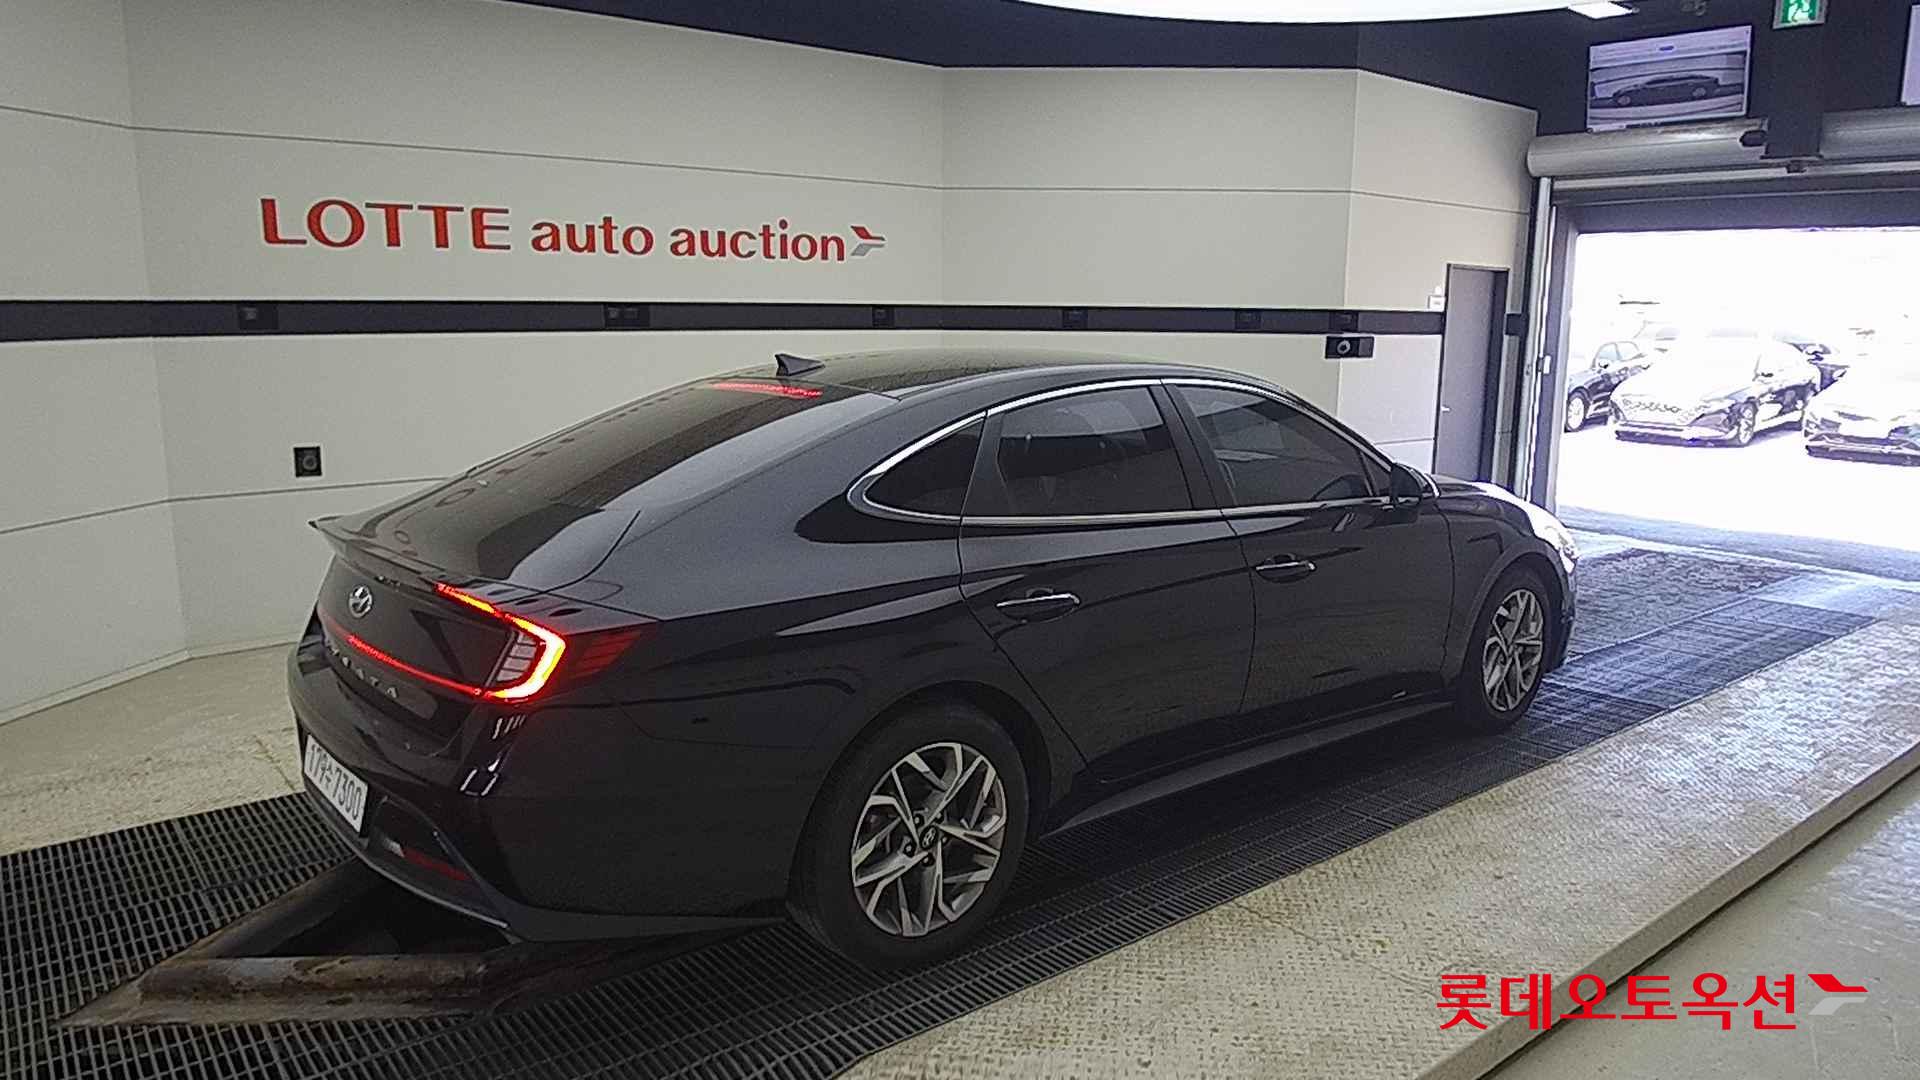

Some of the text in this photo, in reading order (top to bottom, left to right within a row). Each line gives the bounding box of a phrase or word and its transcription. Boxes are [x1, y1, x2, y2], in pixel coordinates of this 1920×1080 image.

[261, 198, 846, 262] LOTTE auto auction
